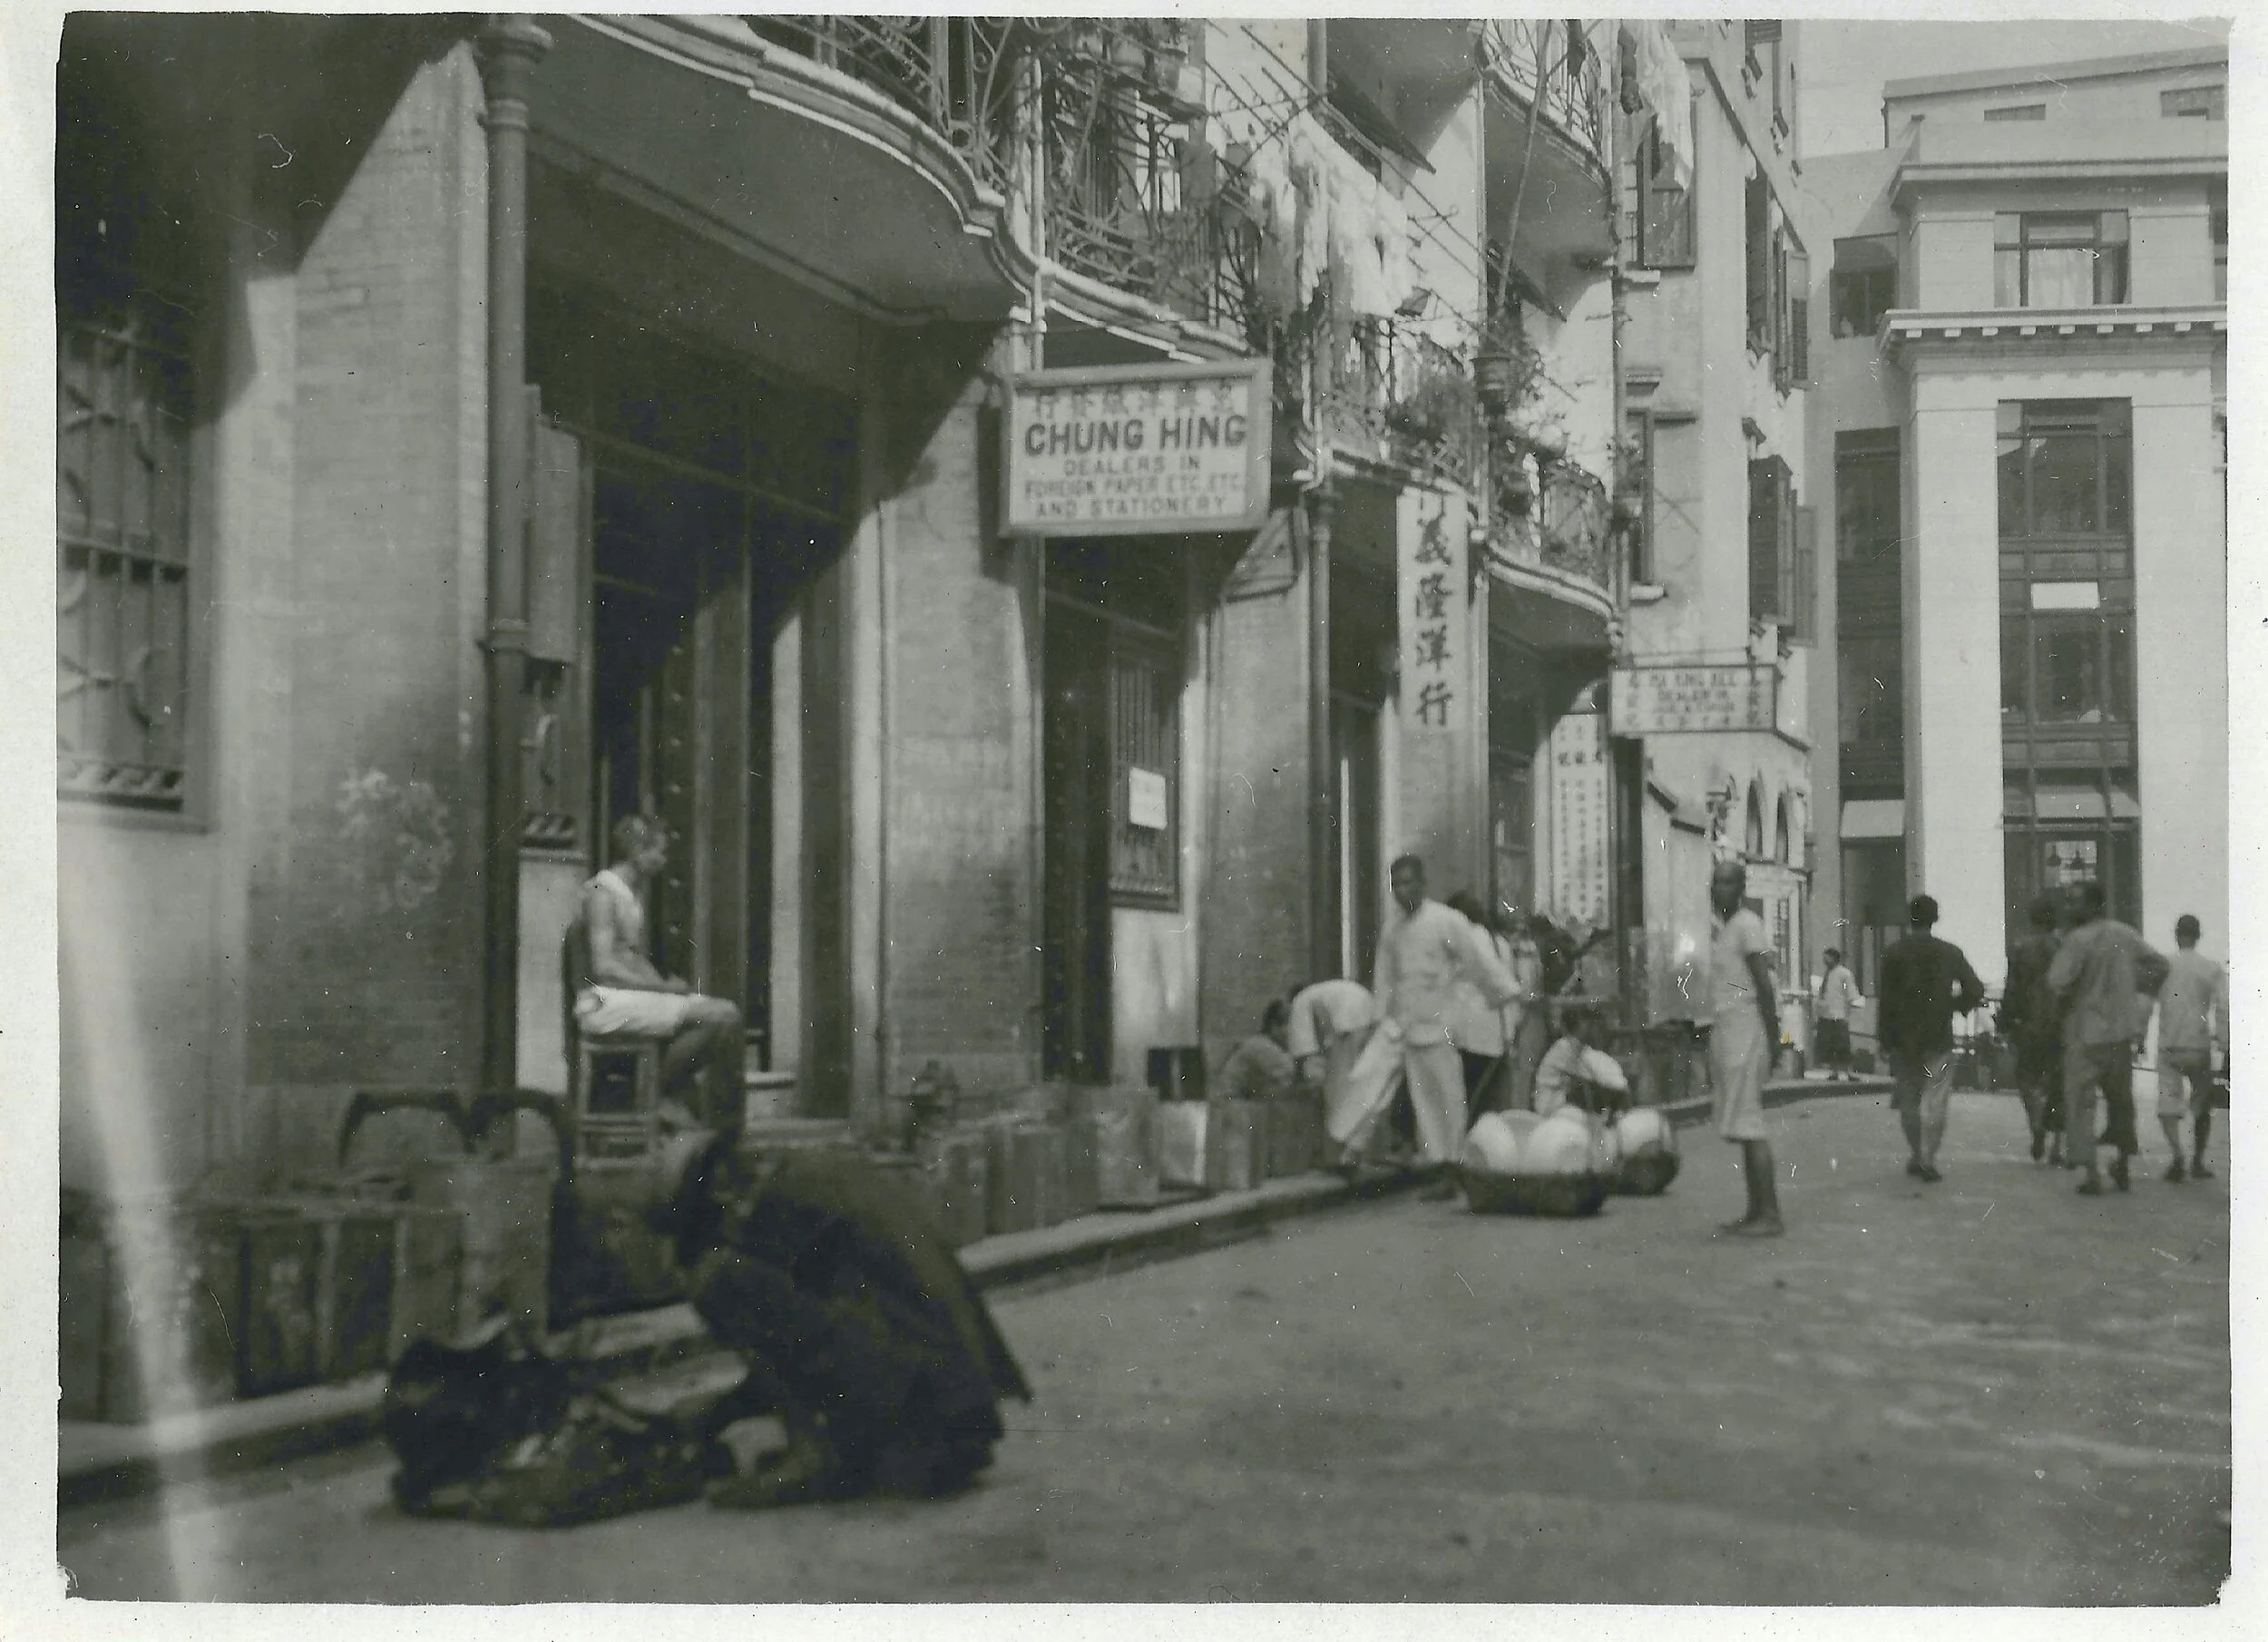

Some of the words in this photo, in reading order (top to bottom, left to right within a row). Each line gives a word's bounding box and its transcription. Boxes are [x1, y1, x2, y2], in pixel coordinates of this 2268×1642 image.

[1024, 418, 1145, 456] CHUNG
[1159, 415, 1247, 451] HING
[1064, 455, 1166, 476] DEALERS
[1179, 455, 1200, 472] IN
[1037, 500, 1078, 518] AND
[1090, 495, 1227, 517] STATIONERY
